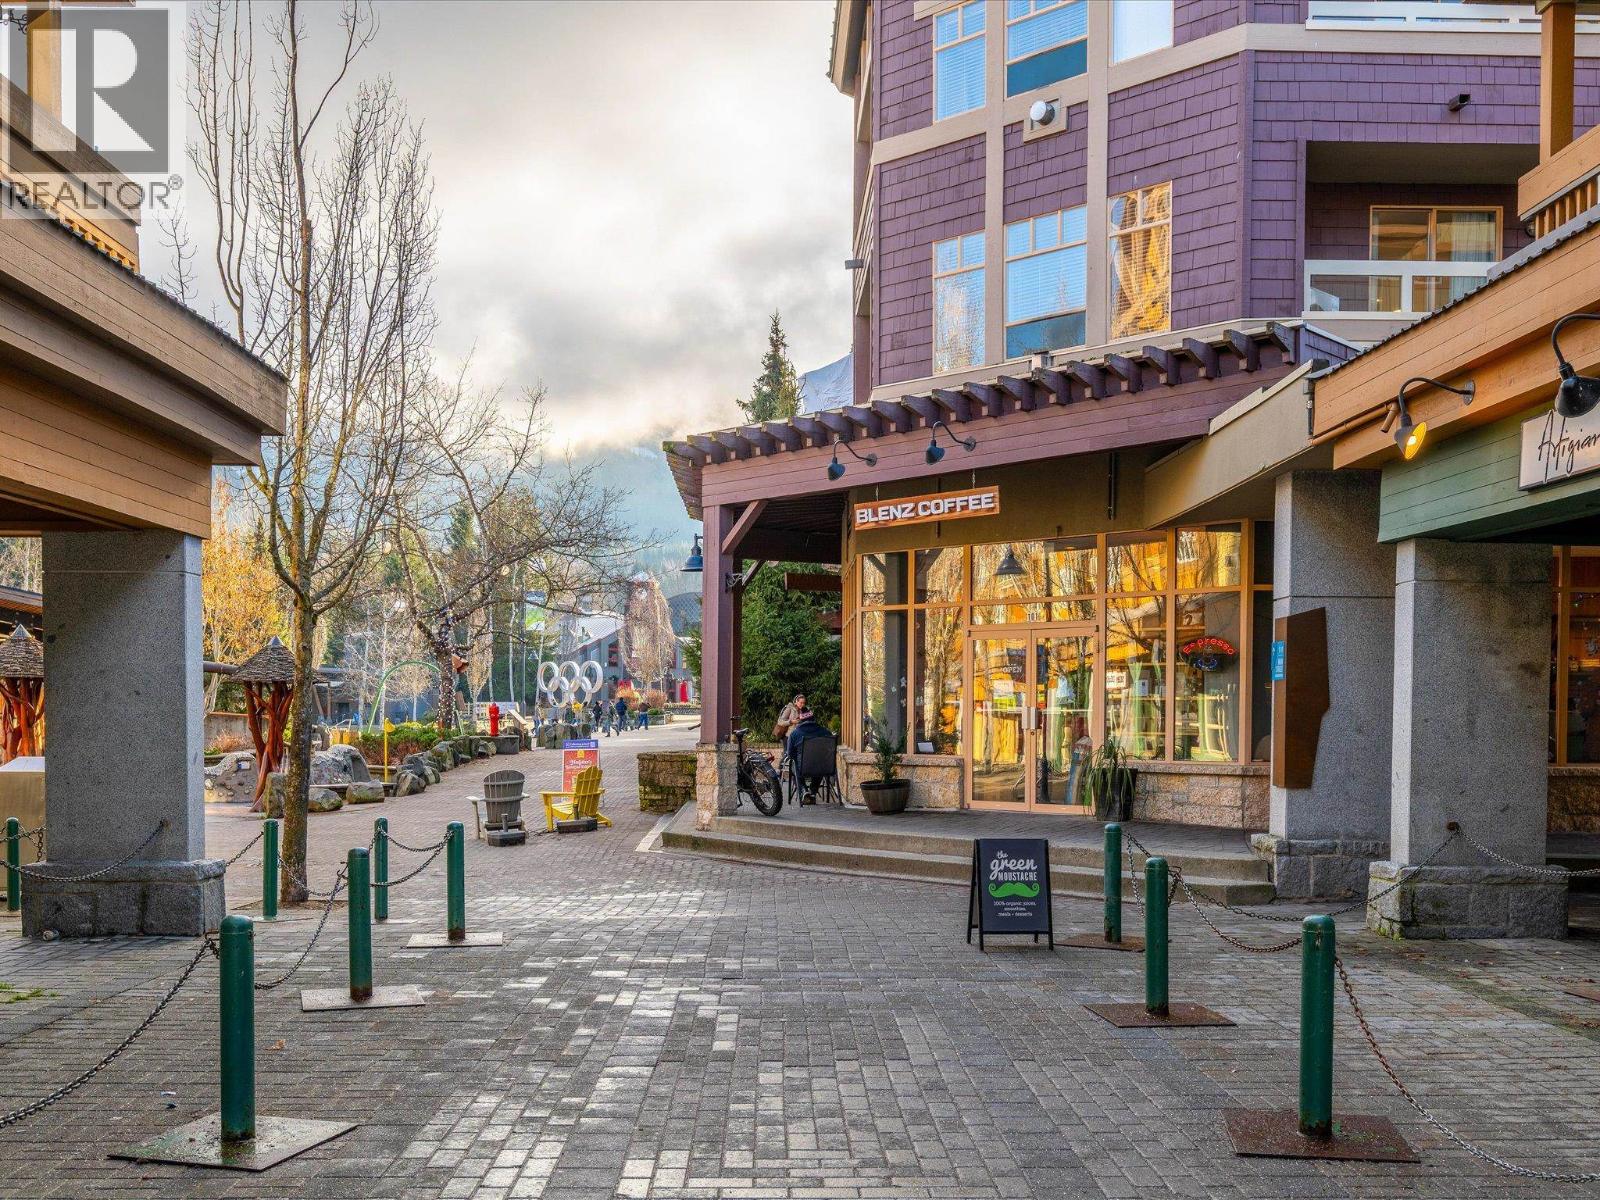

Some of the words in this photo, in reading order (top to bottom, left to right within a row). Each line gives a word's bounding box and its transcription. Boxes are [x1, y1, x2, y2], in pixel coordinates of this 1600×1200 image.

[856, 502, 915, 523] BLENZ
[917, 493, 995, 516] COFFEE
[997, 850, 1009, 859] the
[989, 859, 1038, 881] green
[998, 871, 1038, 881] MOUSTACHE
